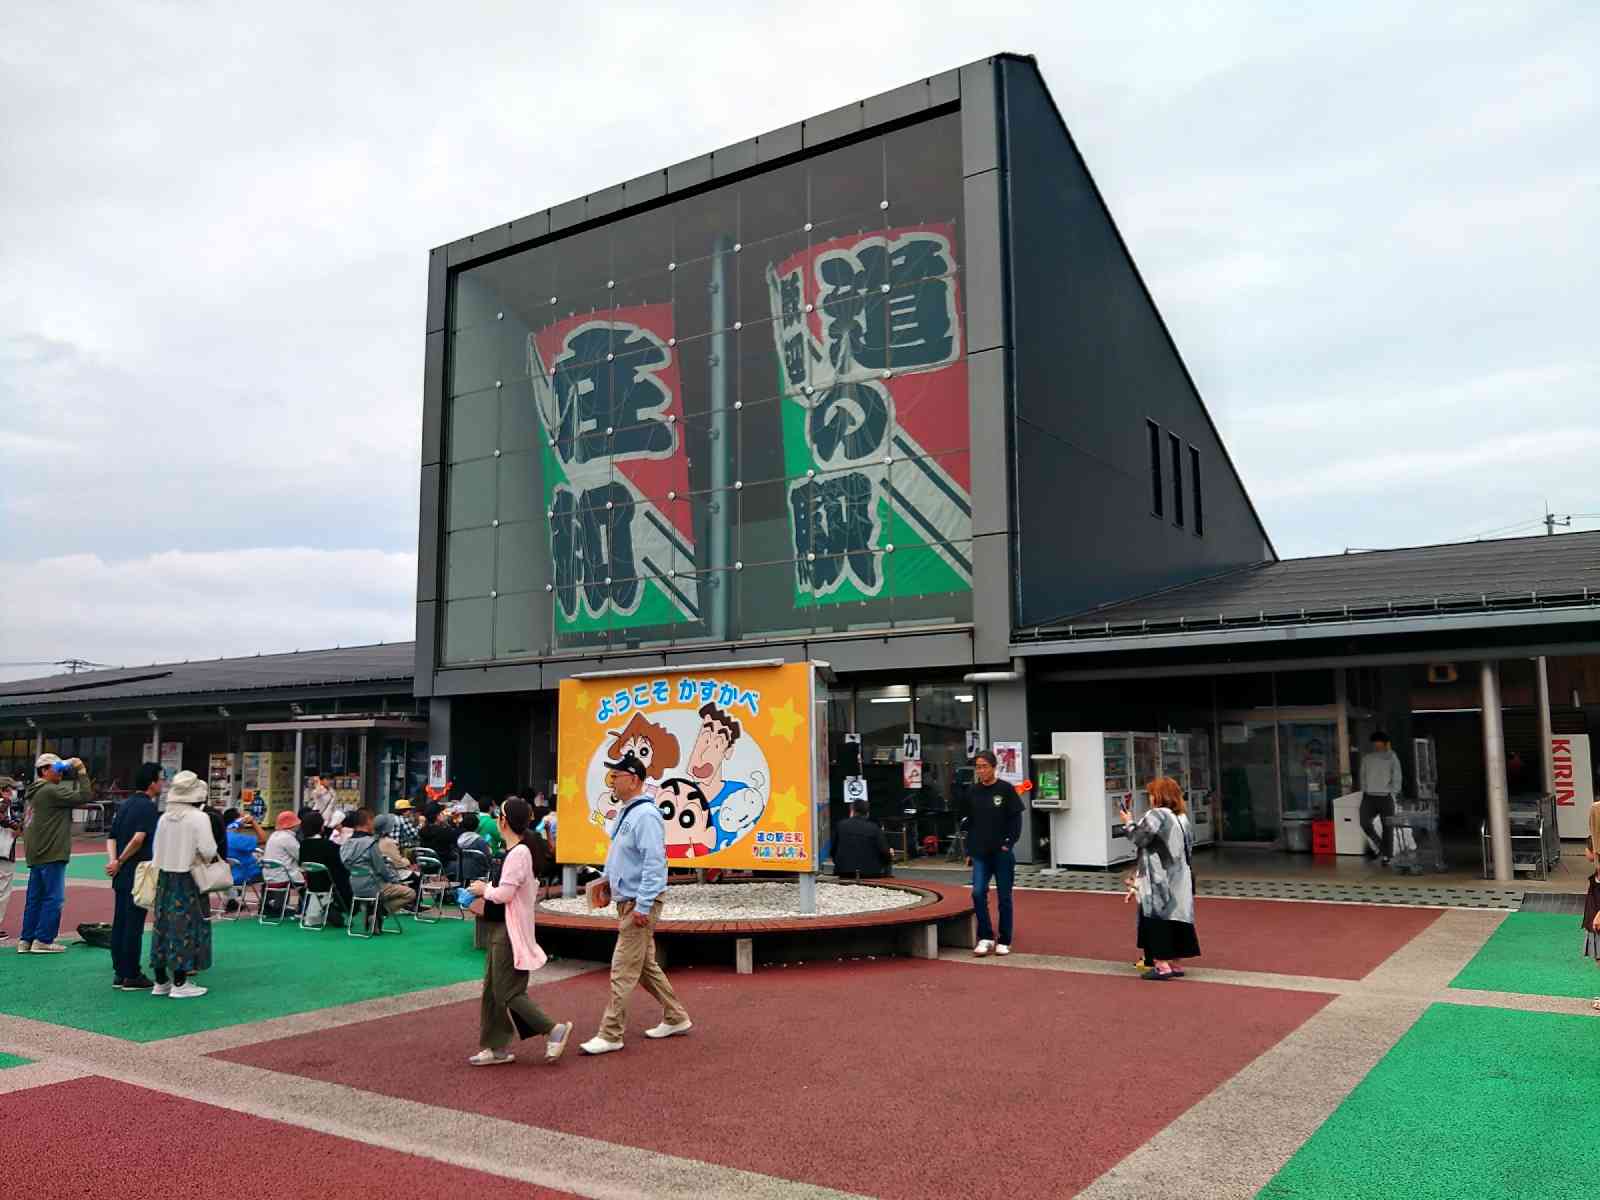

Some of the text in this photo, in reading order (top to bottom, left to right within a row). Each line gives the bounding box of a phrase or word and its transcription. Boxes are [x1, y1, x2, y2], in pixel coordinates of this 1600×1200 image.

[790, 237, 957, 593] 道の駅
[597, 679, 759, 721] ようこそ かすかべ
[1551, 739, 1575, 806] KIRIN
